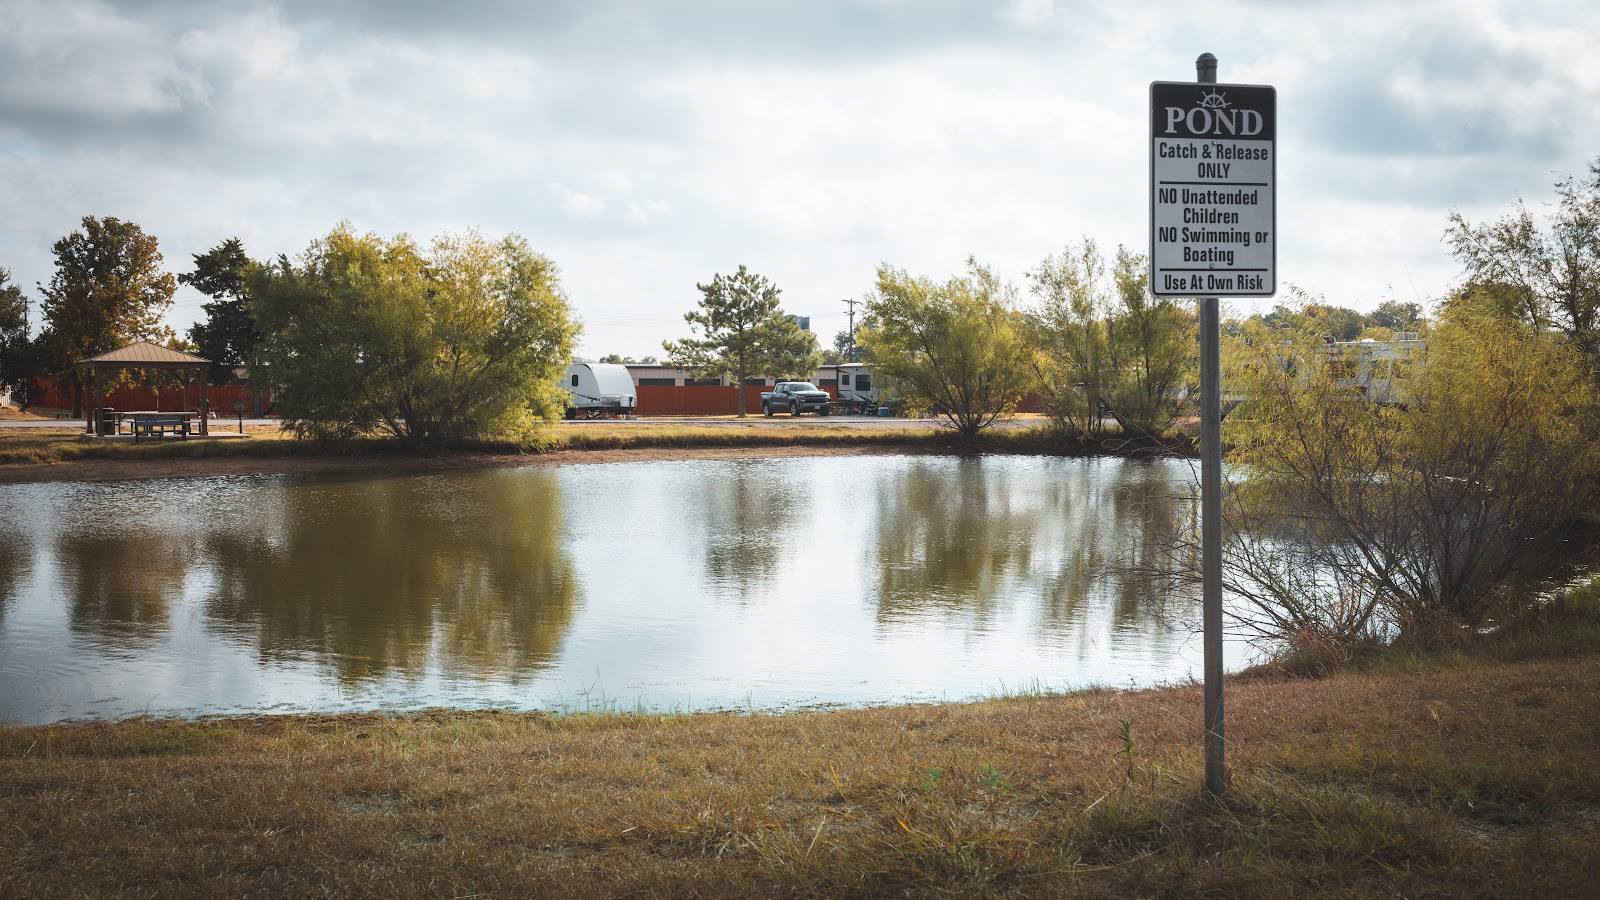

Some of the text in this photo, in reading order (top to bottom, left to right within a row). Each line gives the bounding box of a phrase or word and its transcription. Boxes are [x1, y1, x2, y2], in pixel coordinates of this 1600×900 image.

[1165, 107, 1263, 136] POND
[1160, 142, 1268, 160] Catch & Release
[1198, 163, 1230, 178] ONLY
[1159, 188, 1258, 205] NO Unattended
[1184, 208, 1238, 224] Children
[1159, 227, 1268, 246] NO Swimming or
[1184, 247, 1234, 265] Boating
[1165, 275, 1263, 290] Use At Own Risk
